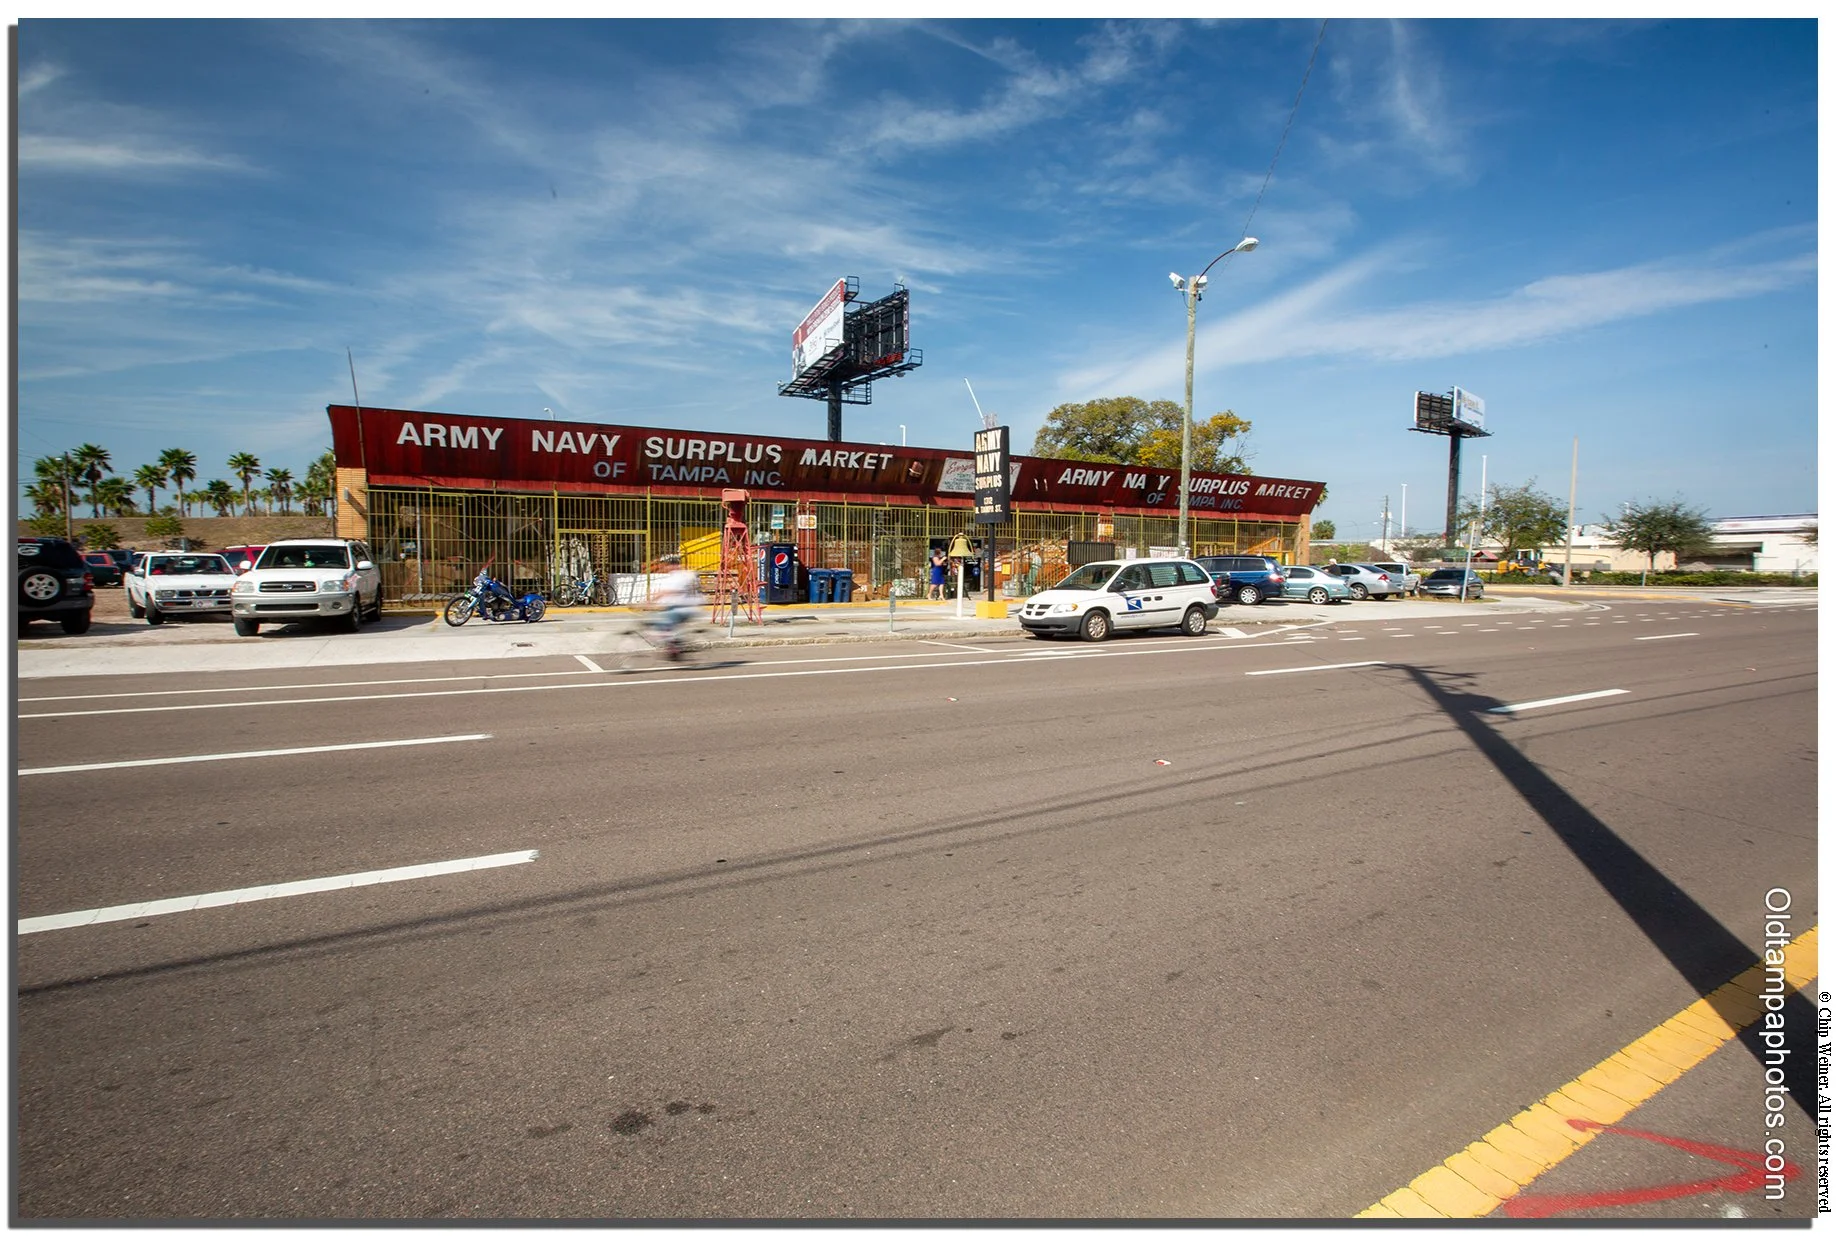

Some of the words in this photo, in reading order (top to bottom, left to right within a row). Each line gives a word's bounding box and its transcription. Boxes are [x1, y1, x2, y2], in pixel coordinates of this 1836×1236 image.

[396, 421, 504, 451] ARMY
[531, 429, 621, 457] NAVY
[644, 436, 783, 464] SURPLUS
[799, 448, 894, 470] MARKET
[975, 429, 1002, 453] ARMY
[593, 461, 628, 478] OF
[648, 463, 731, 484] TAMPA
[743, 470, 785, 486] INC.
[976, 451, 1001, 475] NAVY
[975, 474, 1003, 490] SURPLUS
[1057, 468, 1114, 487] ARMY
[1255, 483, 1313, 500] MARKET
[1146, 492, 1166, 505] OF
[1173, 493, 1216, 508] TMPA
